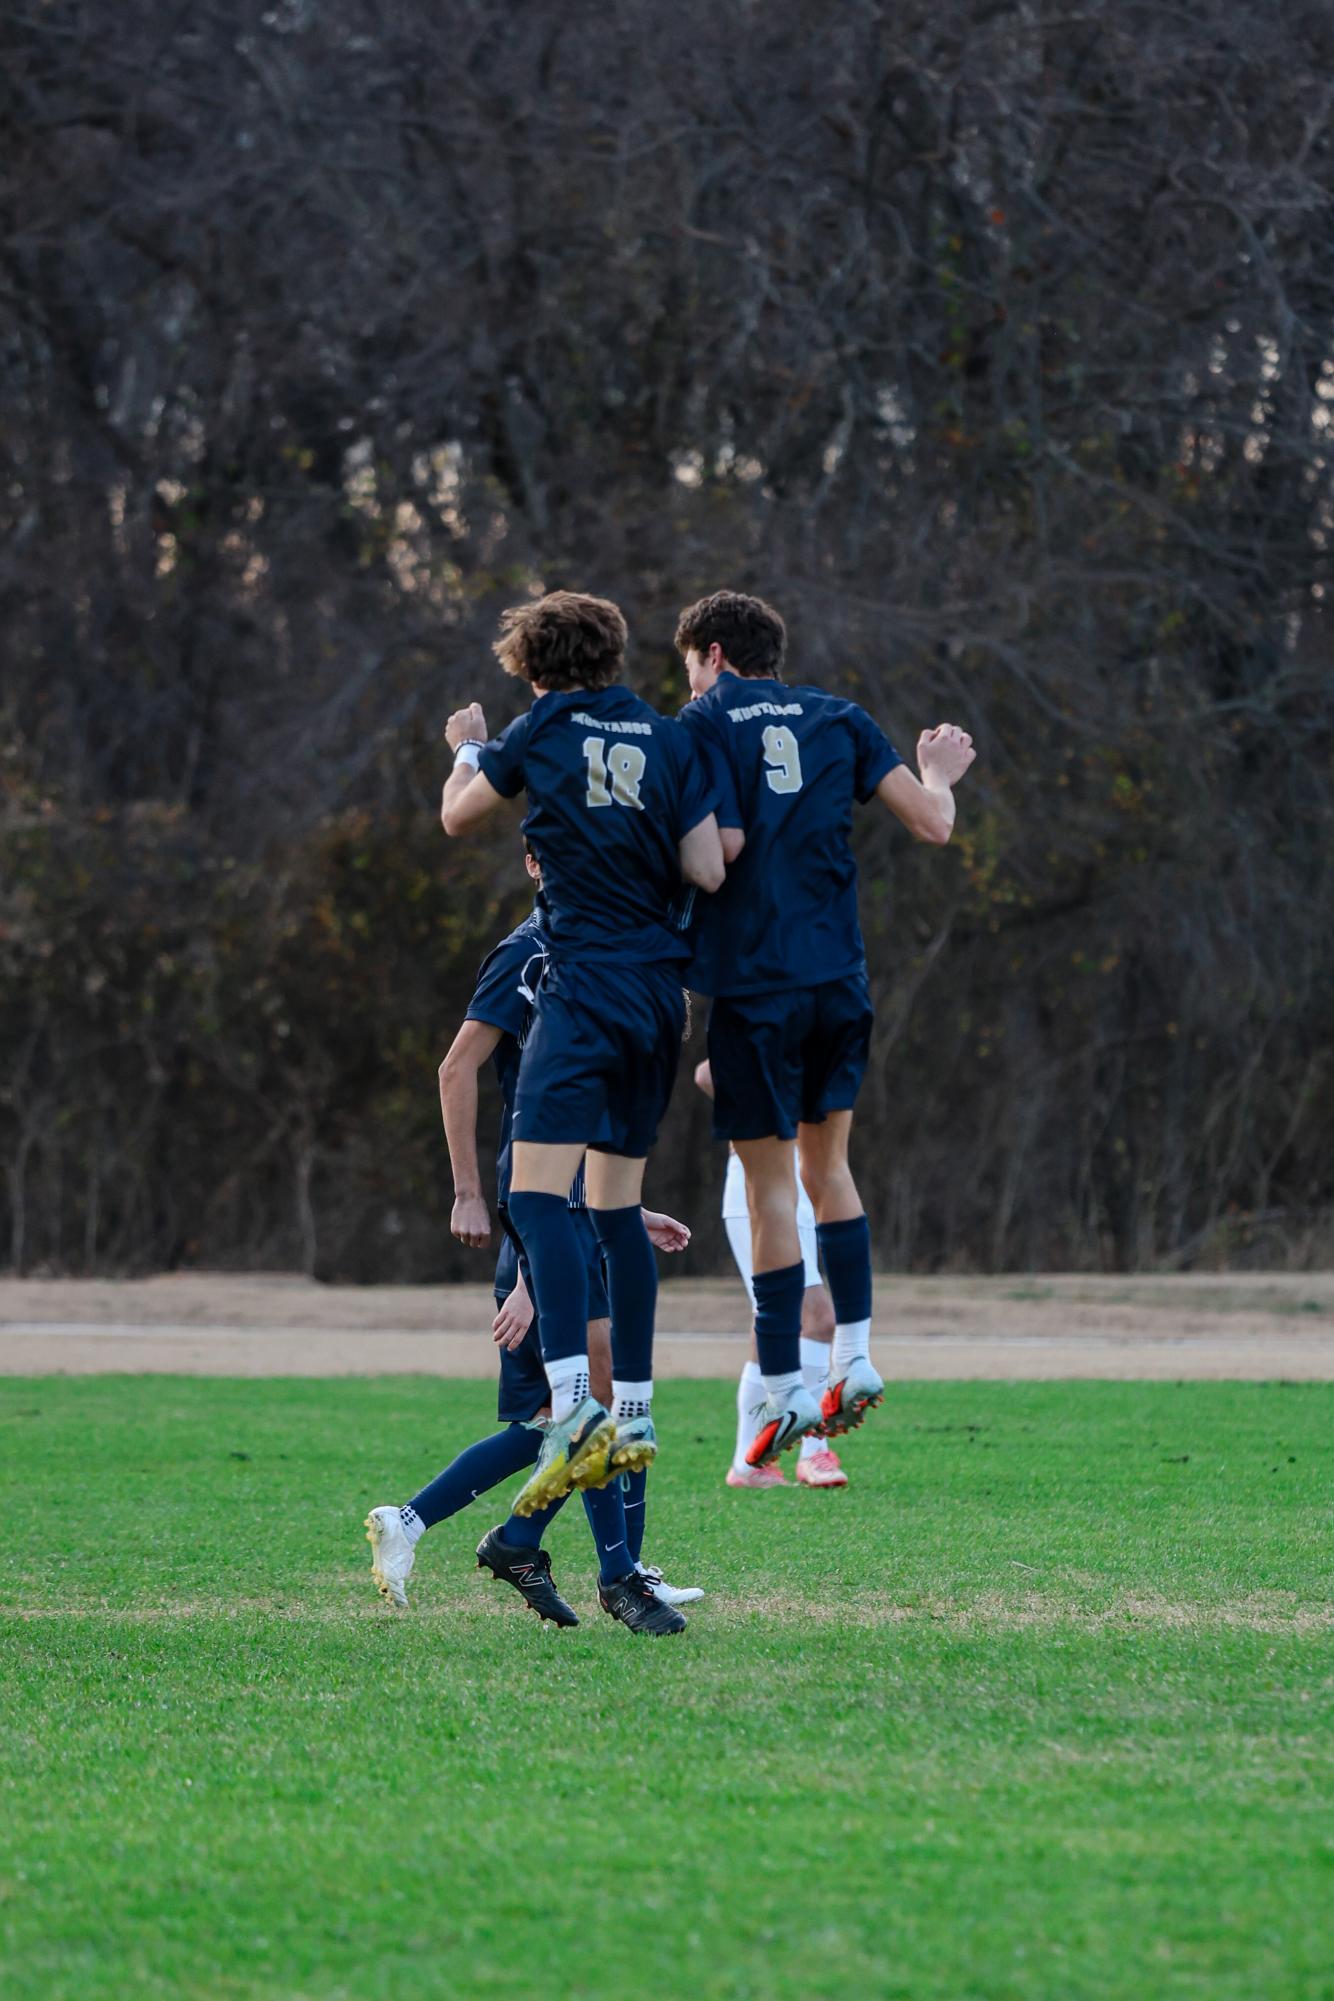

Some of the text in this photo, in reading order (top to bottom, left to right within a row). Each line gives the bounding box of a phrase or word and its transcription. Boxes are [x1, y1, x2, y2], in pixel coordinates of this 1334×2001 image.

[583, 736, 646, 811] 18
[762, 725, 803, 794] 9
[509, 1563, 546, 1587] N
